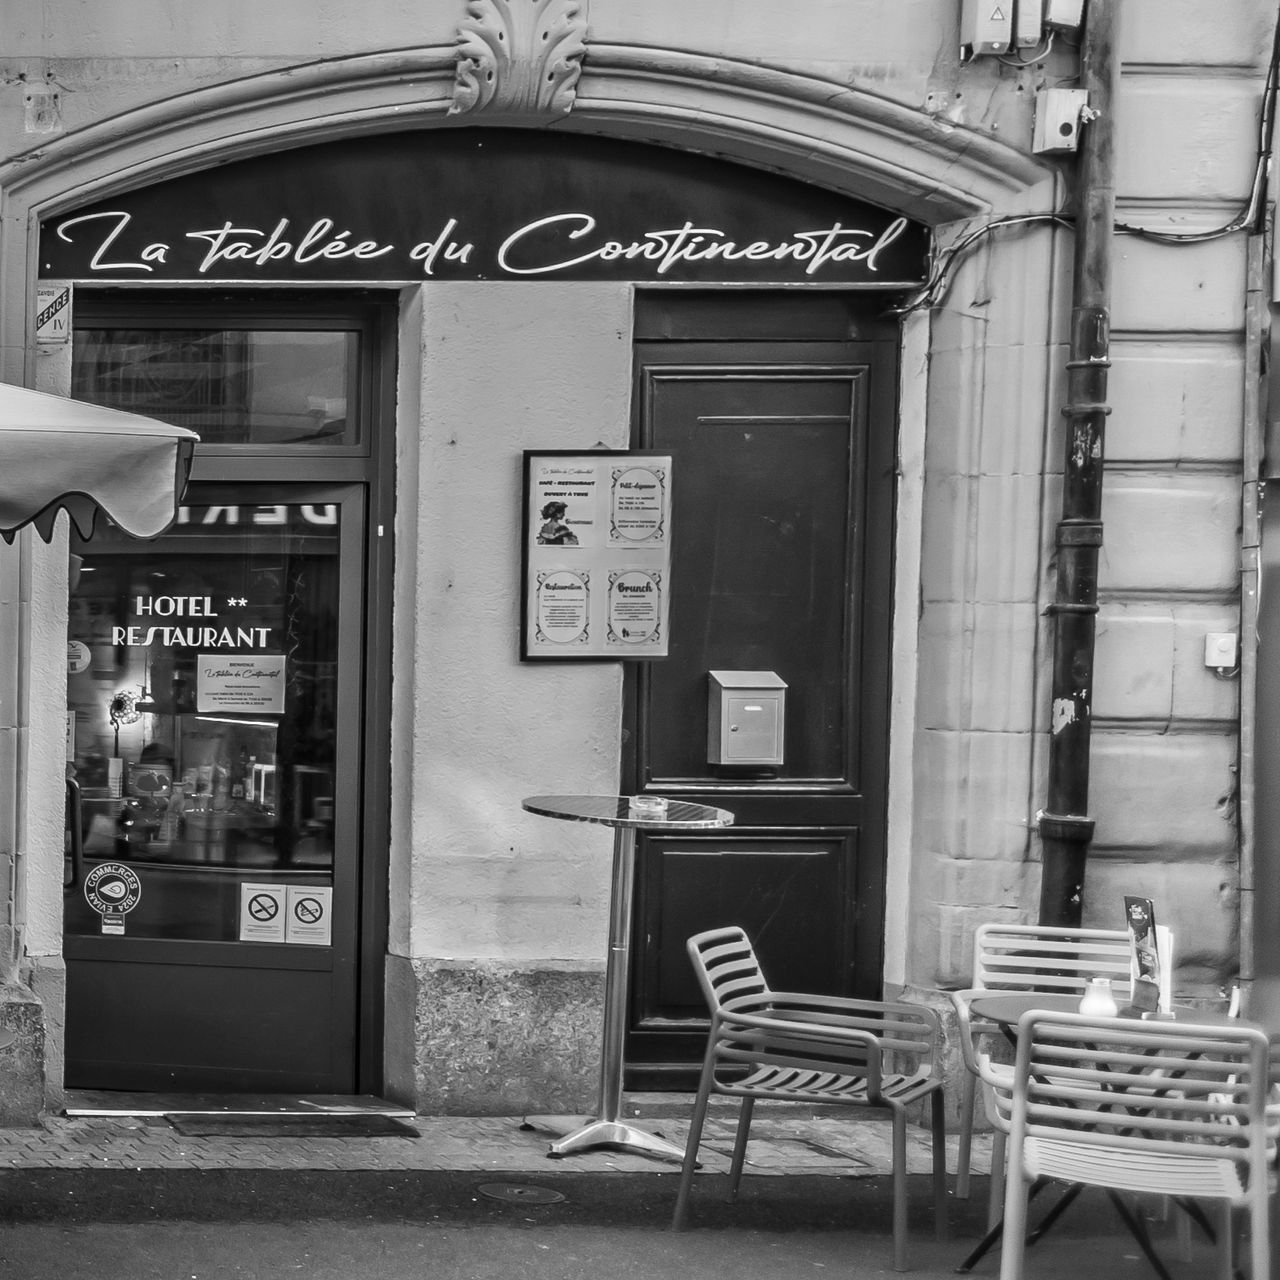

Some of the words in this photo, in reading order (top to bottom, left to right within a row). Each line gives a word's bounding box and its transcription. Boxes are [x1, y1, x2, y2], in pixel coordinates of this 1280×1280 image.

[57, 211, 170, 272] La
[185, 217, 395, 273] tablée
[409, 218, 474, 275] du
[497, 213, 907, 275] Continental
[53, 319, 65, 330] IV
[617, 581, 653, 593] Brunch
[136, 595, 218, 617] HOTEL
[112, 626, 272, 648] RESTAURANT
[87, 865, 138, 890] COMMERCES
[88, 892, 113, 914] EVIAN
[117, 894, 137, 912] 2024
